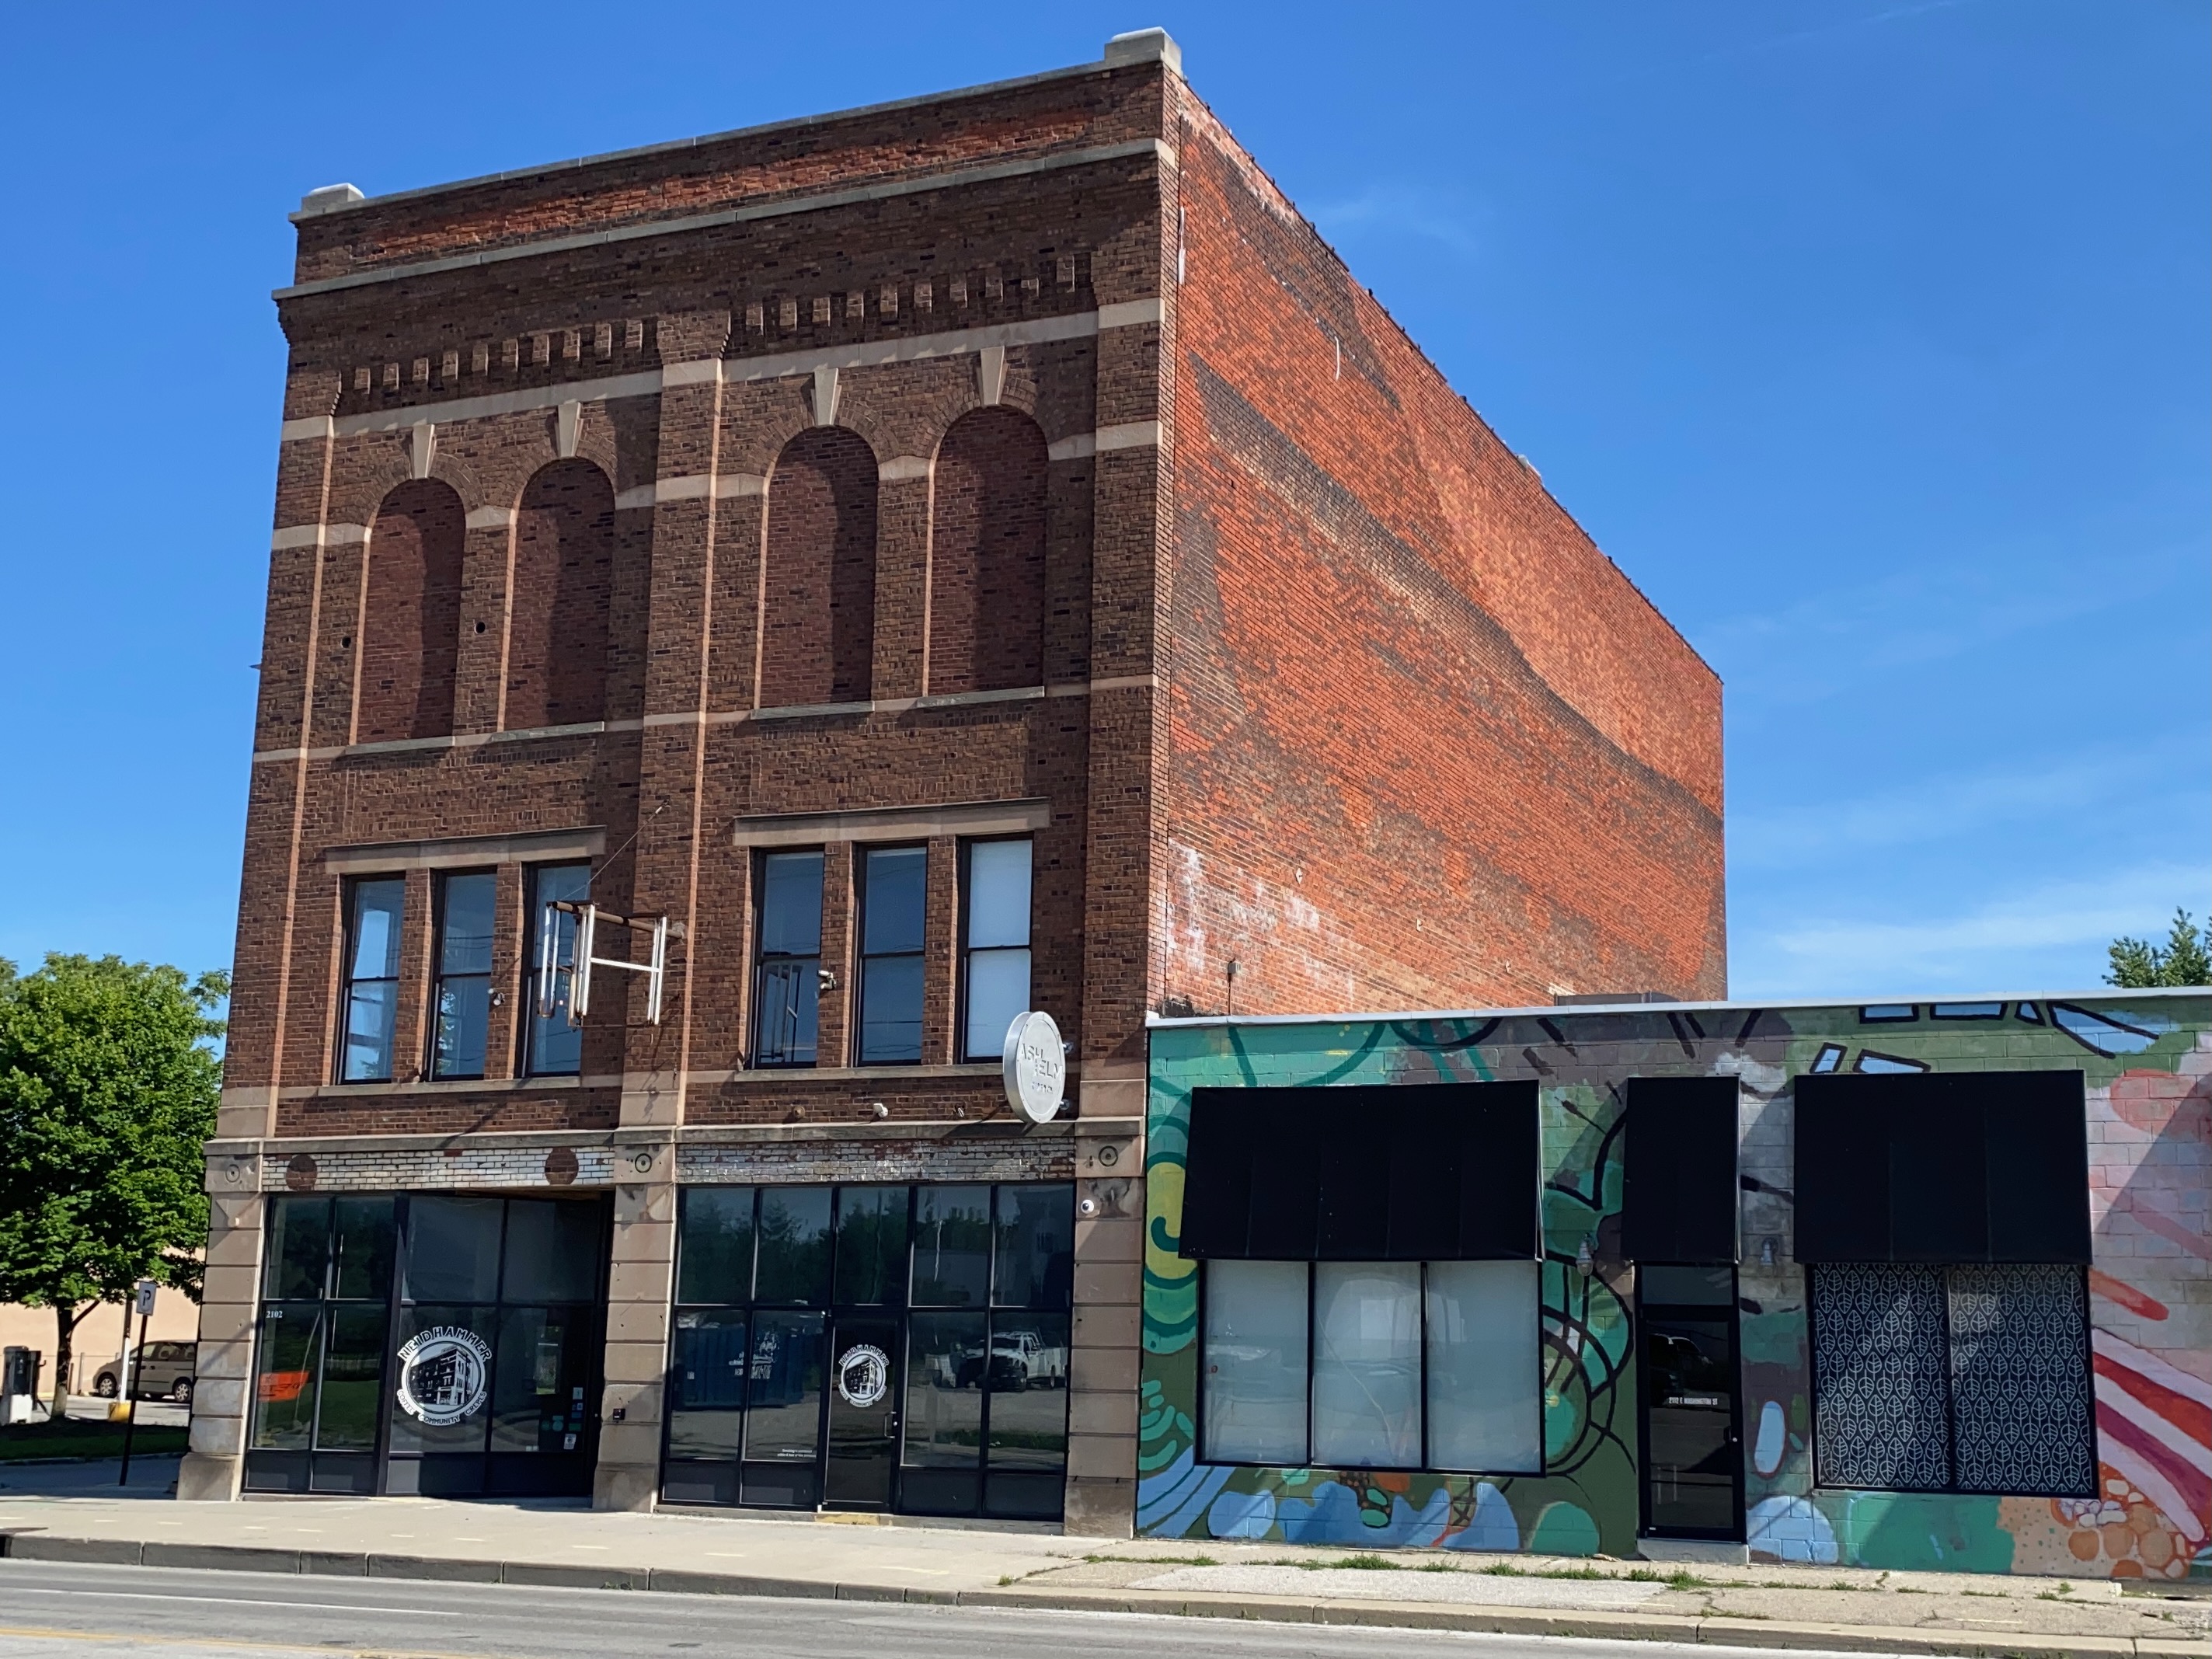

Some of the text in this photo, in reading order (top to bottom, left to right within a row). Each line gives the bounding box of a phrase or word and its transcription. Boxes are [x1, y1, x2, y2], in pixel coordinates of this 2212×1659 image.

[266, 1310, 283, 1319] 2102
[397, 1326, 492, 1361] NEIDHAMMER
[418, 1414, 461, 1425] COMMUNITY
[465, 1392, 487, 1416] CREPES
